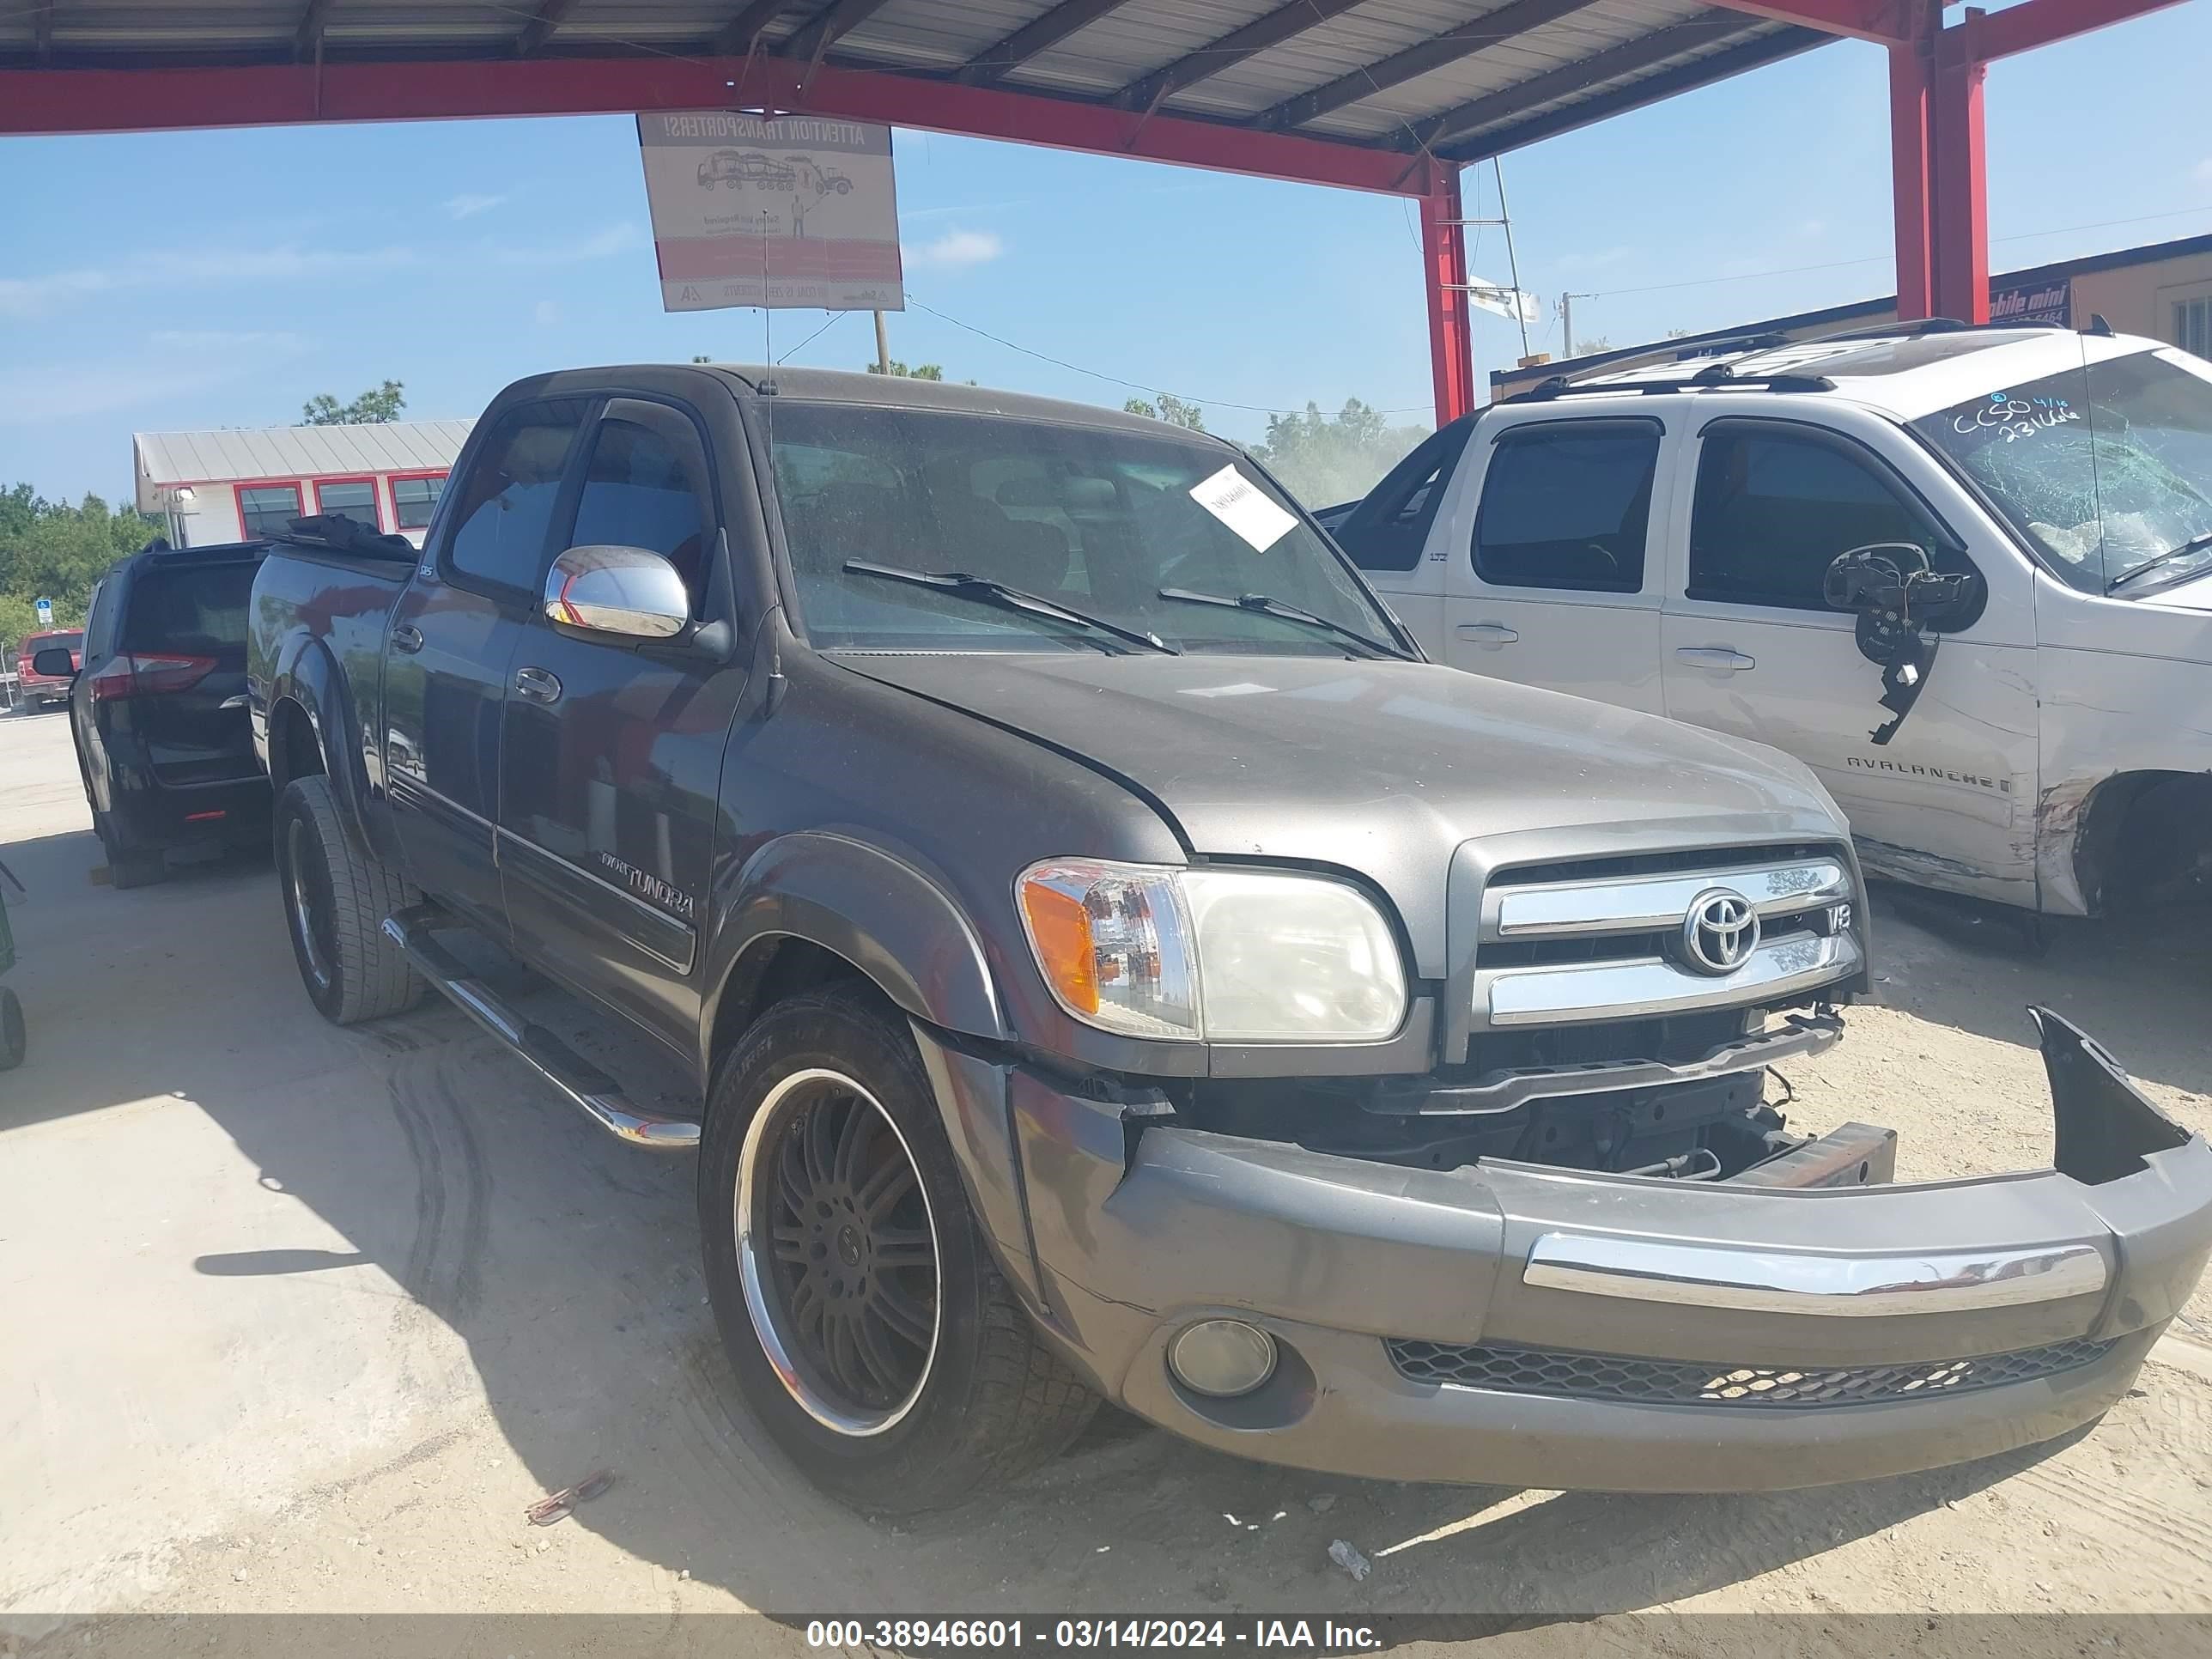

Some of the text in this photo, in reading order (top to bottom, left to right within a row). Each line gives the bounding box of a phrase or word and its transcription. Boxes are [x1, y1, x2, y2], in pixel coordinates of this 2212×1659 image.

[1989, 283, 2068, 318] obile mini
[1847, 757, 1994, 788] AVALANCHE
[626, 863, 694, 919] TUNDRA
[1826, 903, 1851, 935] V8
